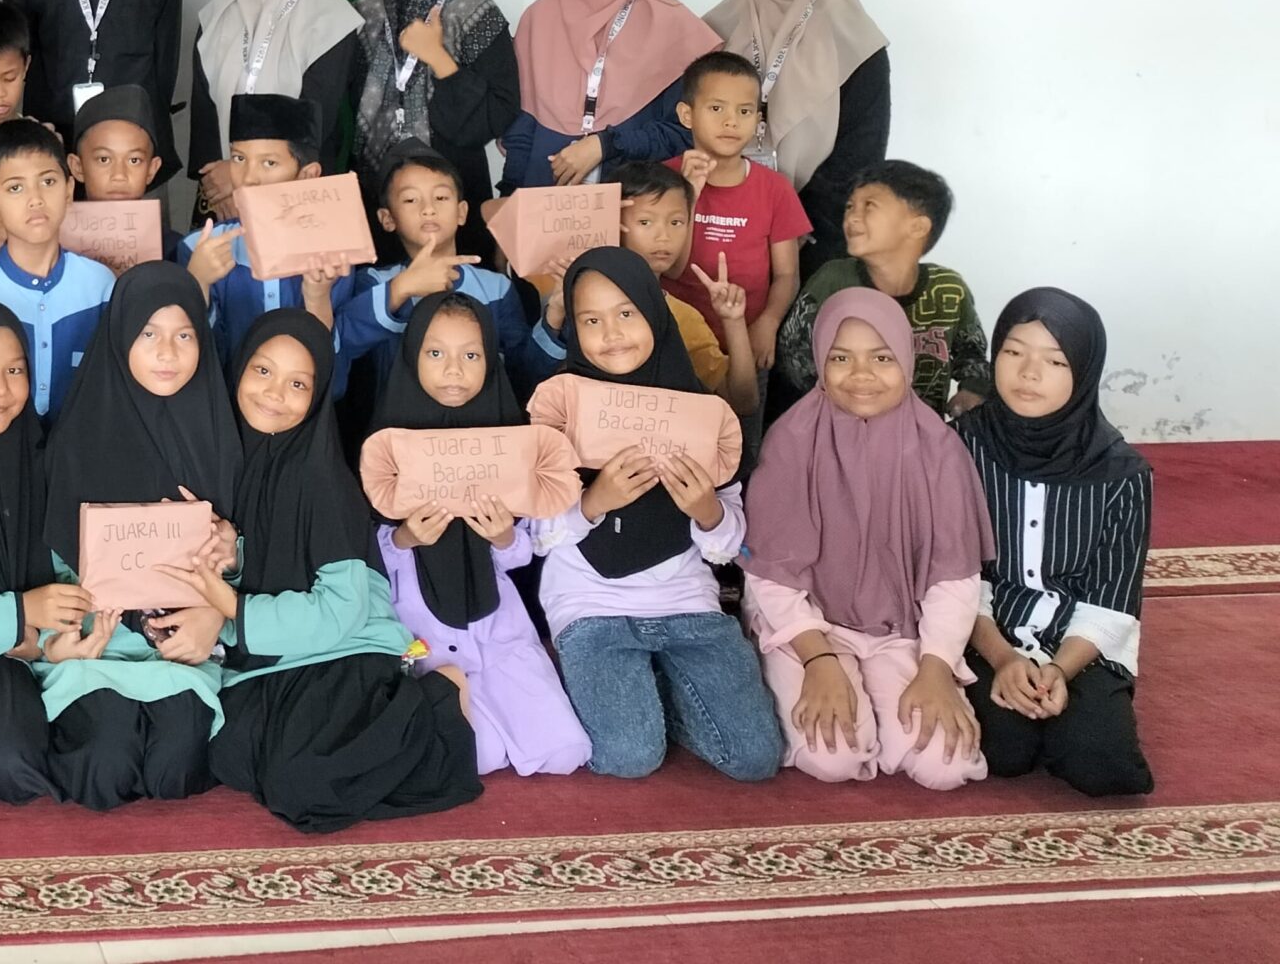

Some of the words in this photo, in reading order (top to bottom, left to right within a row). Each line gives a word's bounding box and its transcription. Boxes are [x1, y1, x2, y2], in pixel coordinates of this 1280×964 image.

[602, 386, 659, 412] Juara
[598, 409, 670, 433] Bacaan
[422, 436, 482, 457] Juara
[432, 461, 500, 484] Bacaan
[103, 521, 159, 543] JUARA
[120, 551, 146, 572] CC
